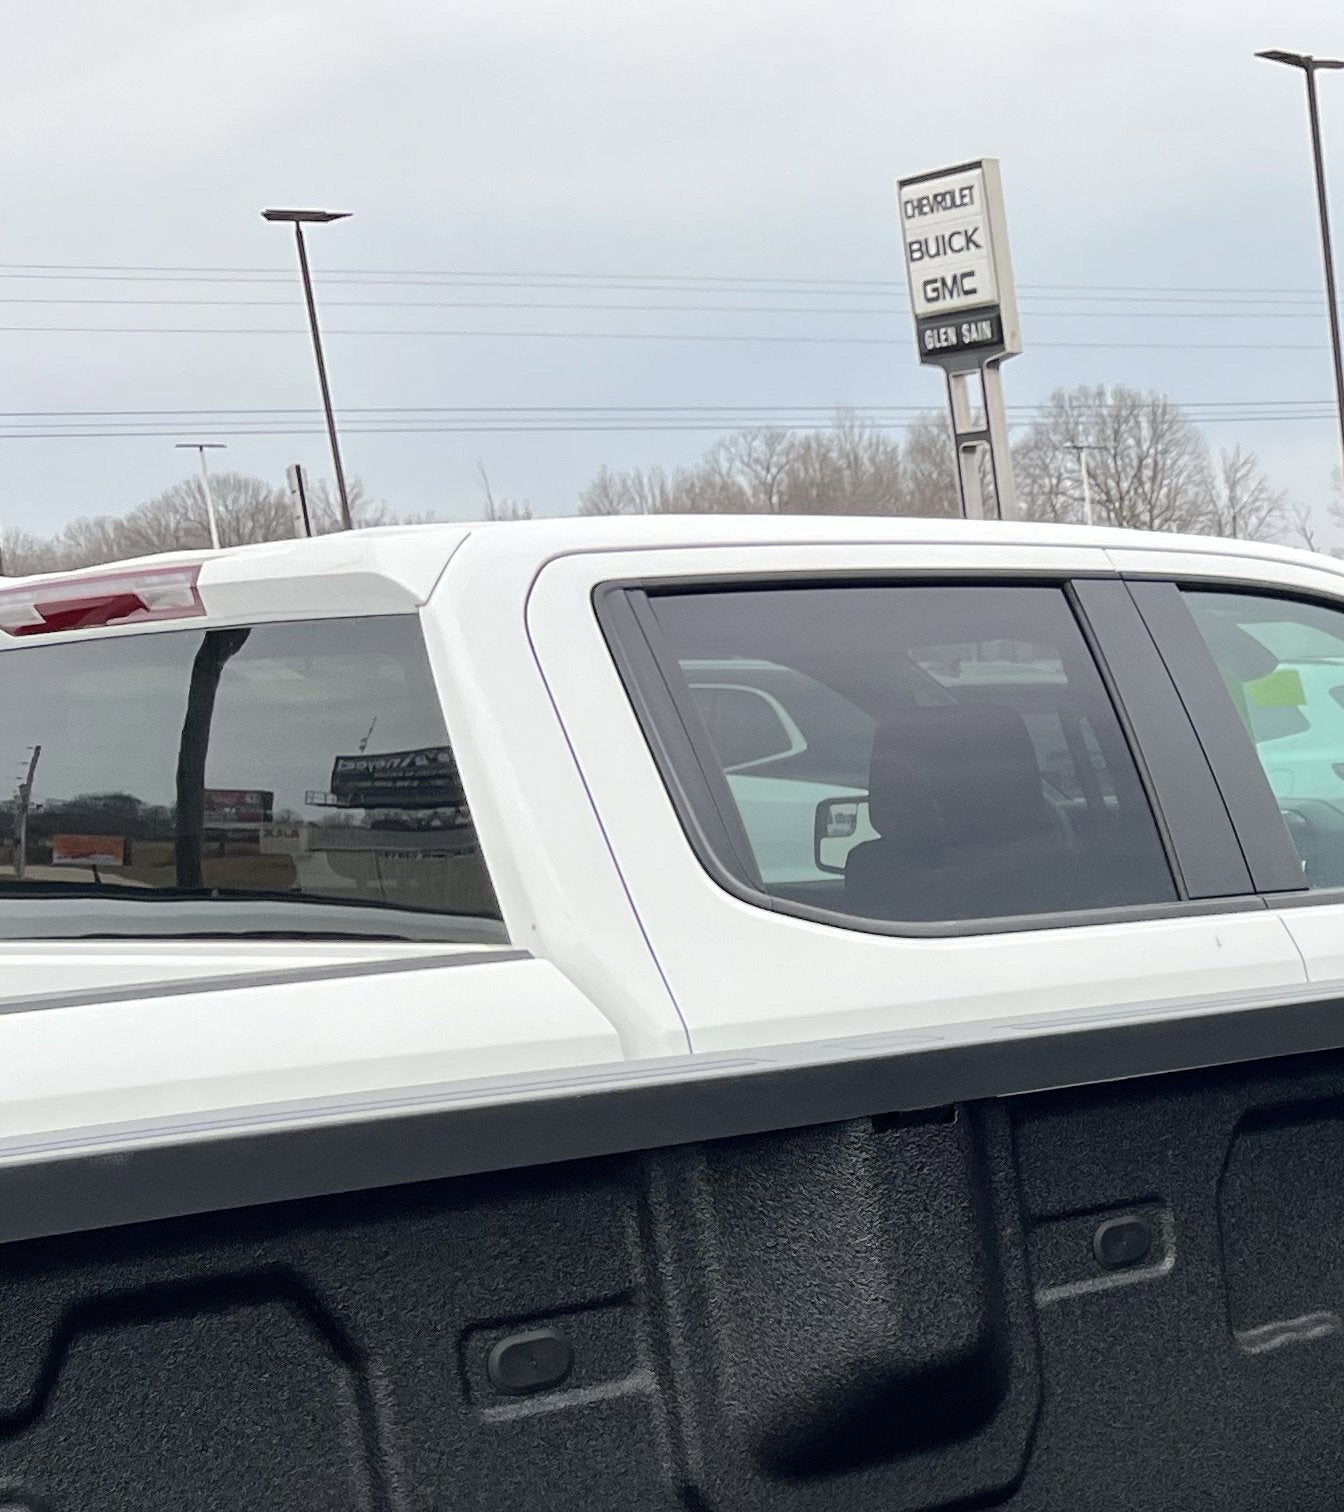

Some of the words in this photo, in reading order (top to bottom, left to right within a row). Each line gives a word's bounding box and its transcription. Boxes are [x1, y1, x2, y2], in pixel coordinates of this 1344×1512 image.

[904, 185, 975, 220] CHEVROLET
[908, 227, 982, 263] BUICK
[922, 270, 978, 303] GMC
[924, 326, 958, 350] GLEN
[961, 320, 993, 344] SAIN
